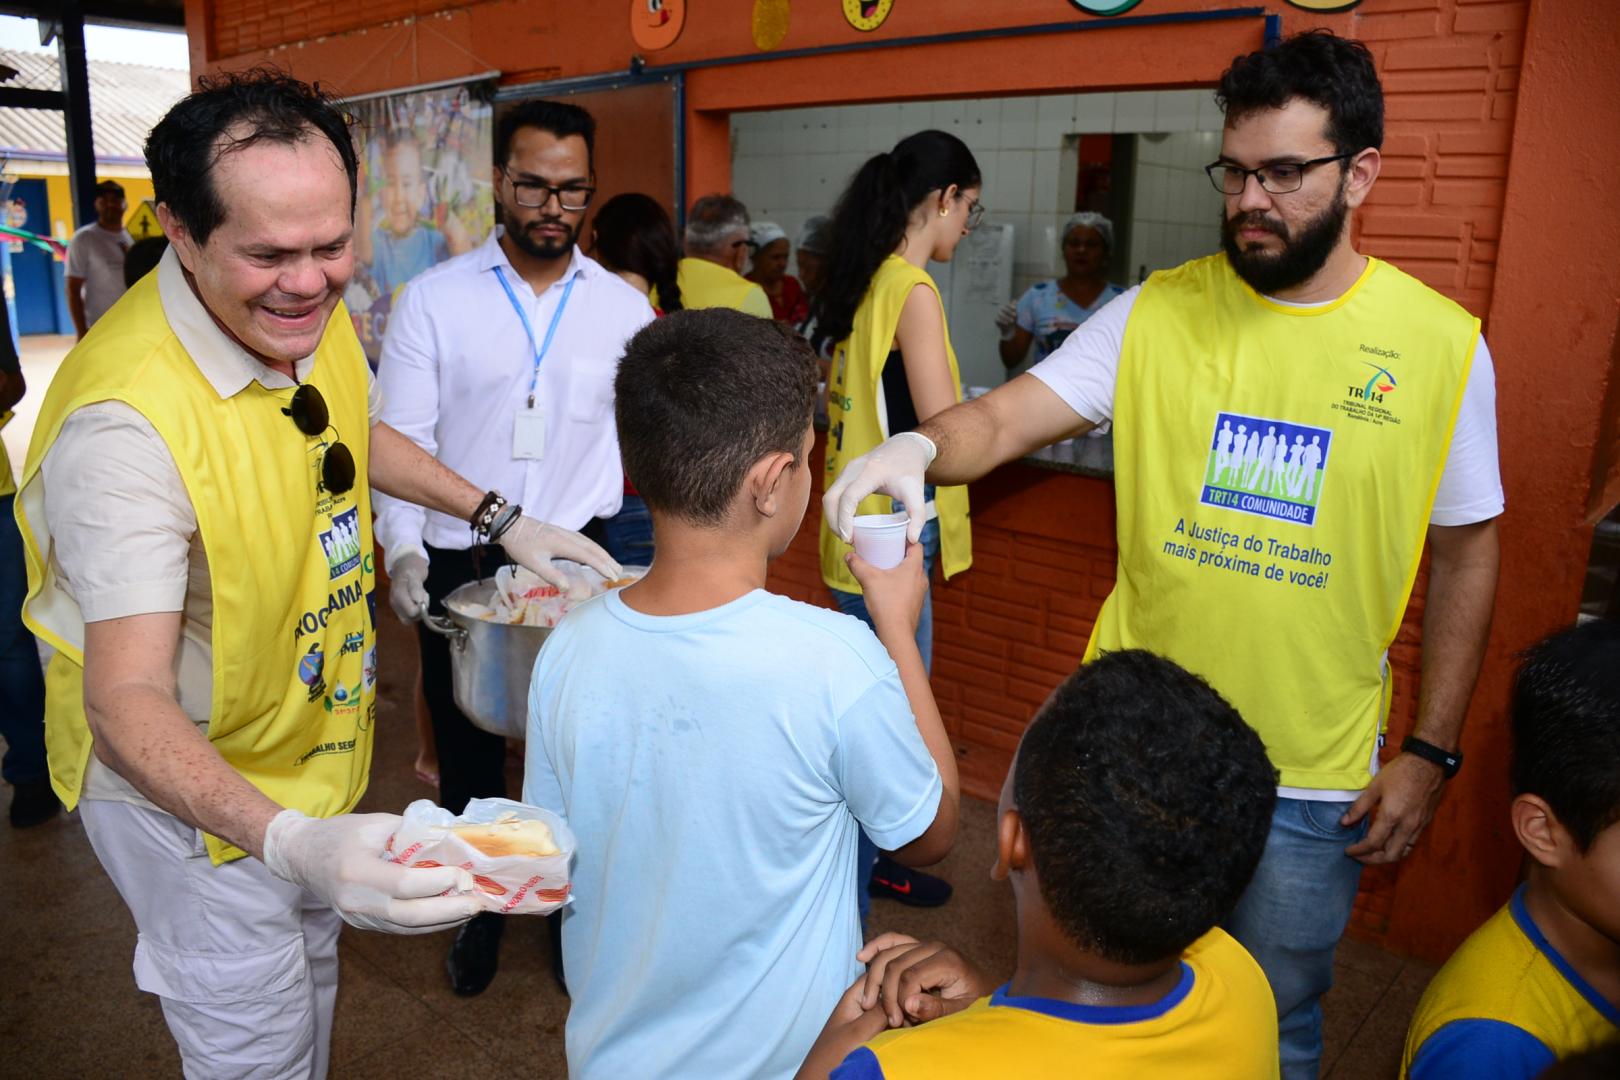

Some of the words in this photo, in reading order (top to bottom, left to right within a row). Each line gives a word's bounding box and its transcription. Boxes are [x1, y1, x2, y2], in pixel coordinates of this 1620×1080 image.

[1359, 344, 1401, 360] Realização:
[1208, 488, 1240, 507] TRT14
[1241, 495, 1309, 522] COMUNIDADE
[1174, 518, 1185, 535] A
[1188, 522, 1240, 550] Justiça
[1243, 534, 1263, 553] do
[1268, 538, 1332, 566] Trabalho
[1163, 541, 1197, 560] mais
[1198, 550, 1260, 577] próxima
[1265, 563, 1284, 581] de
[1289, 571, 1329, 589] você!
